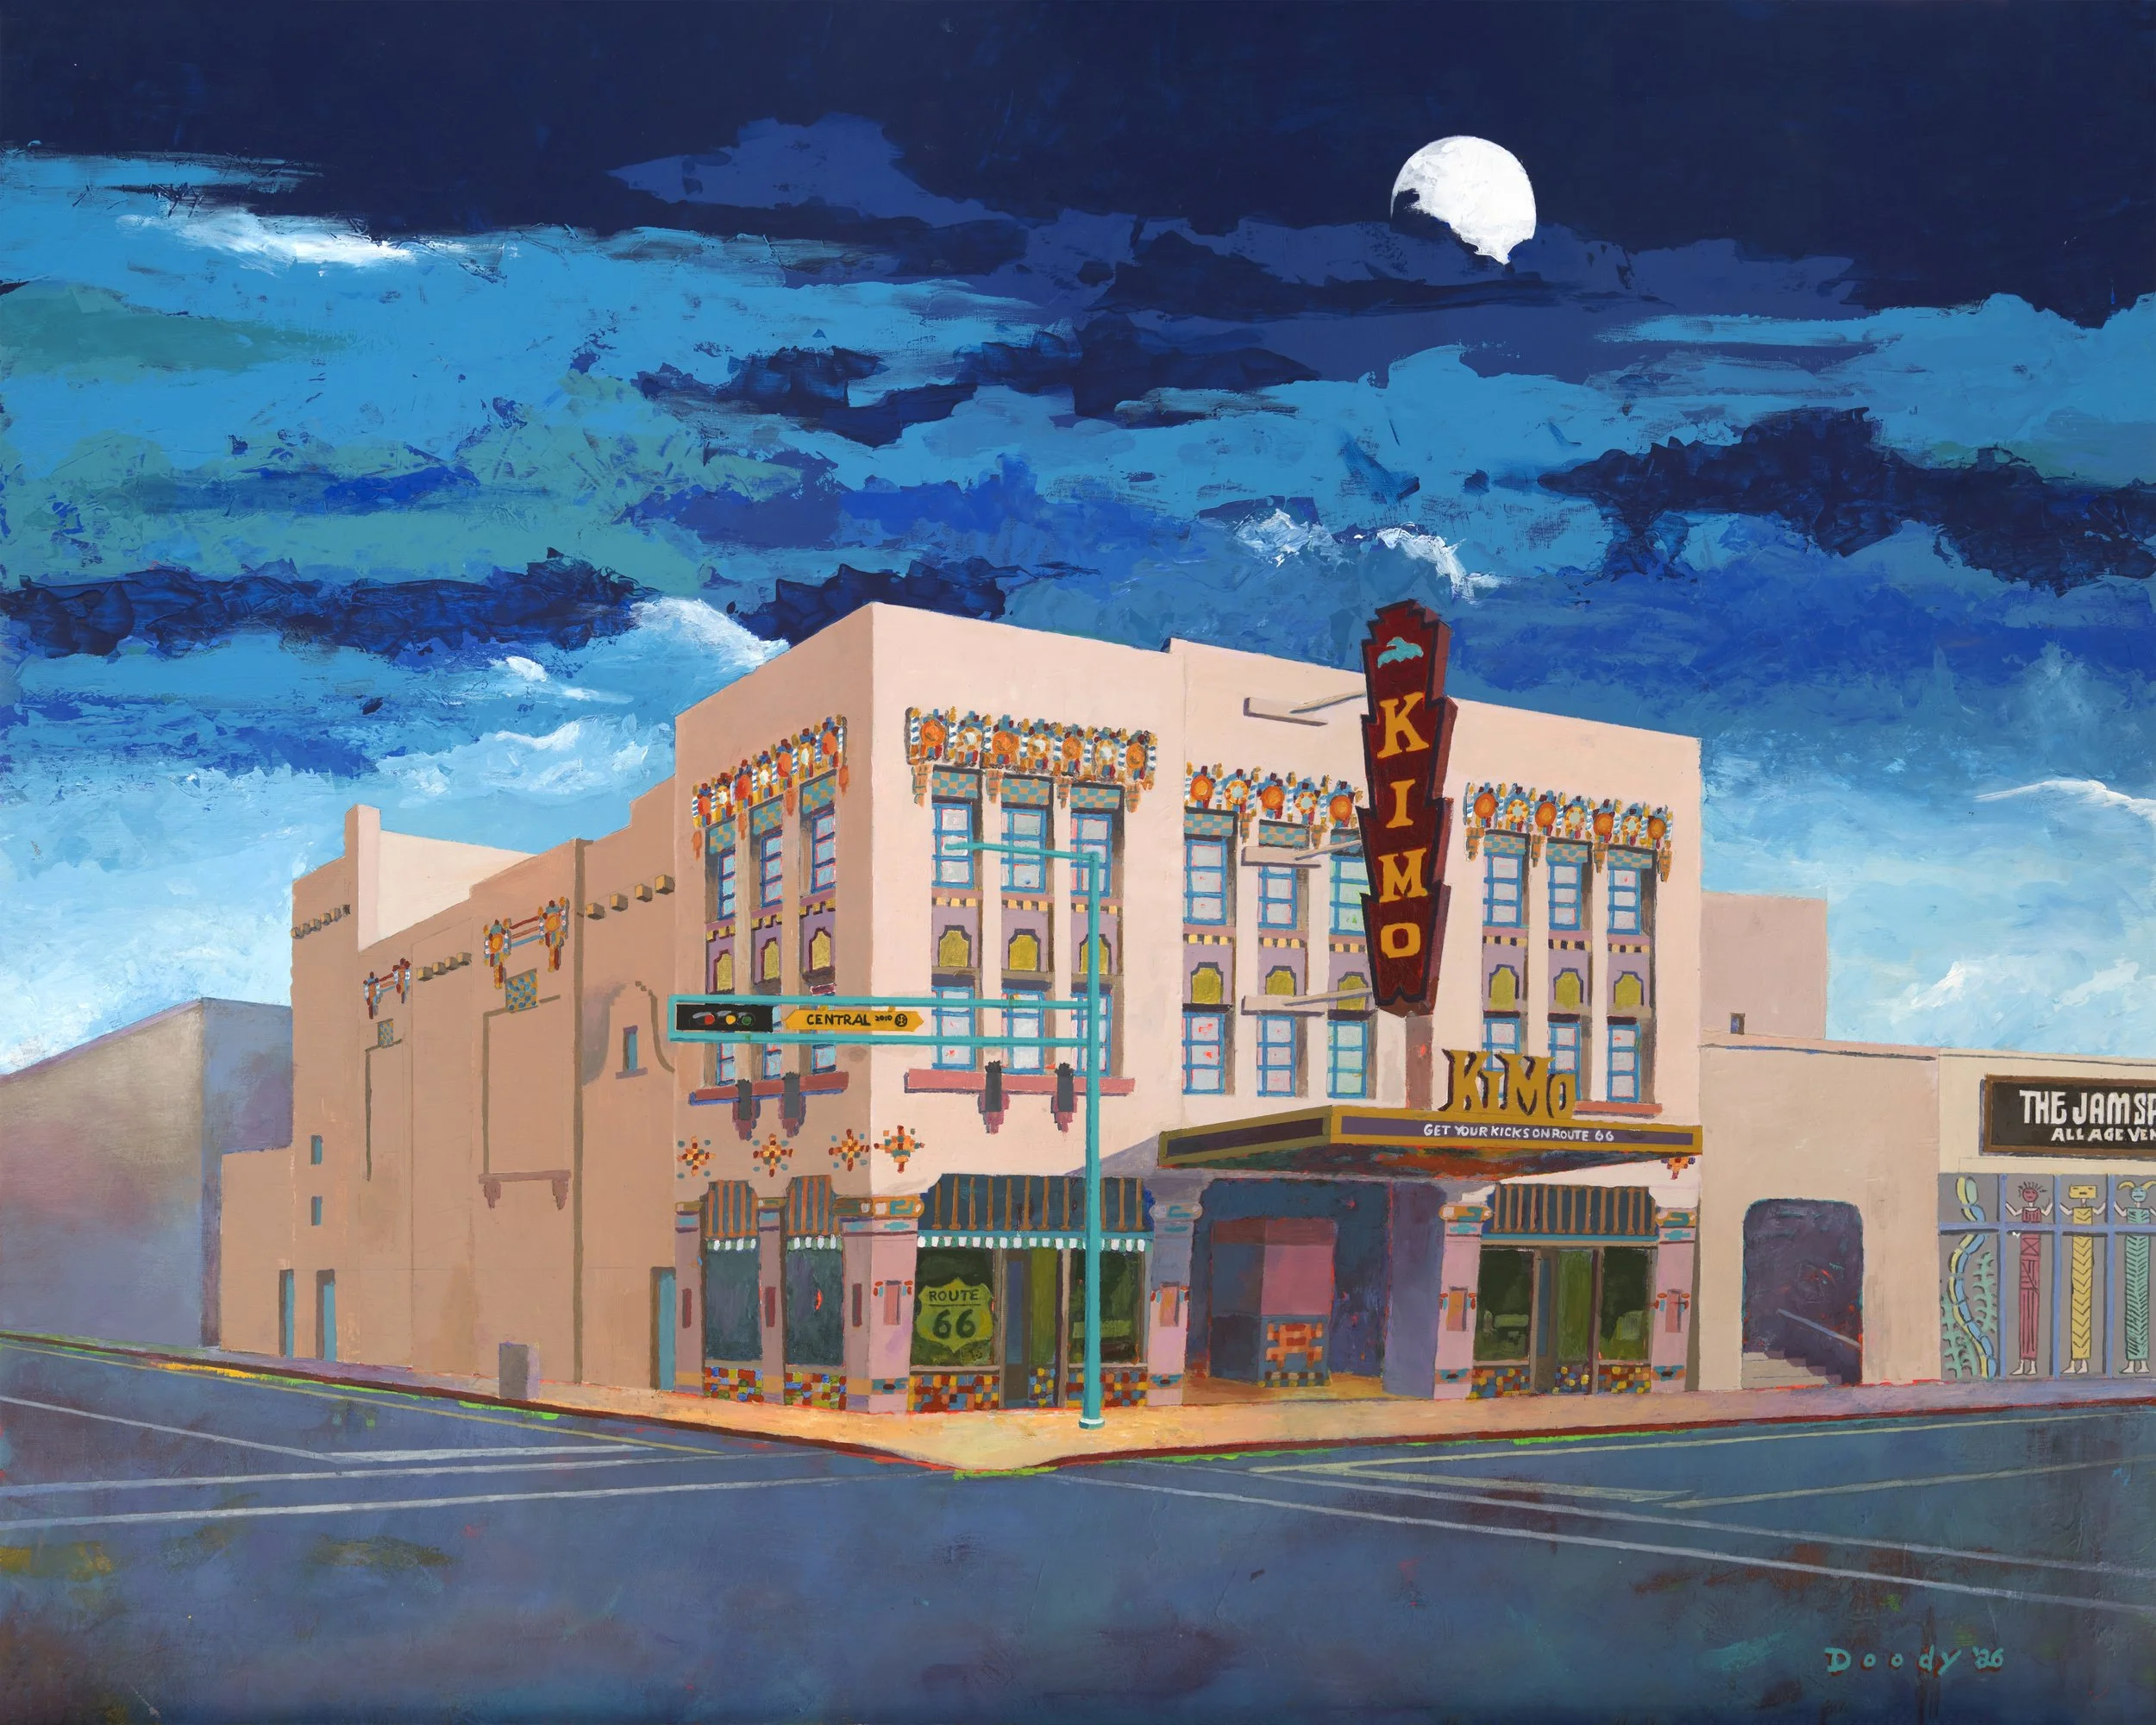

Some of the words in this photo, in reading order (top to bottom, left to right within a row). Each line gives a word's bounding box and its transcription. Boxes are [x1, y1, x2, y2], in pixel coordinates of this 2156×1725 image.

[1376, 692, 1430, 959] KIMO
[806, 1013, 871, 1026] CENTRAL
[2019, 1089, 2067, 1125] THE
[2072, 1091, 2130, 1125] JAM
[1423, 1123, 1451, 1137] GET
[1454, 1125, 1488, 1138] YOUR
[1491, 1126, 1529, 1139] KICKS
[1532, 1127, 1551, 1139] ON
[1551, 1128, 1589, 1142] ROUTE
[1595, 1130, 1614, 1143] 66
[2051, 1127, 2084, 1142] ALL
[2087, 1127, 2124, 1142] AGE
[928, 1289, 980, 1302] ROUTE
[932, 1308, 976, 1339] 66
[1824, 1644, 1962, 1677] Doody
